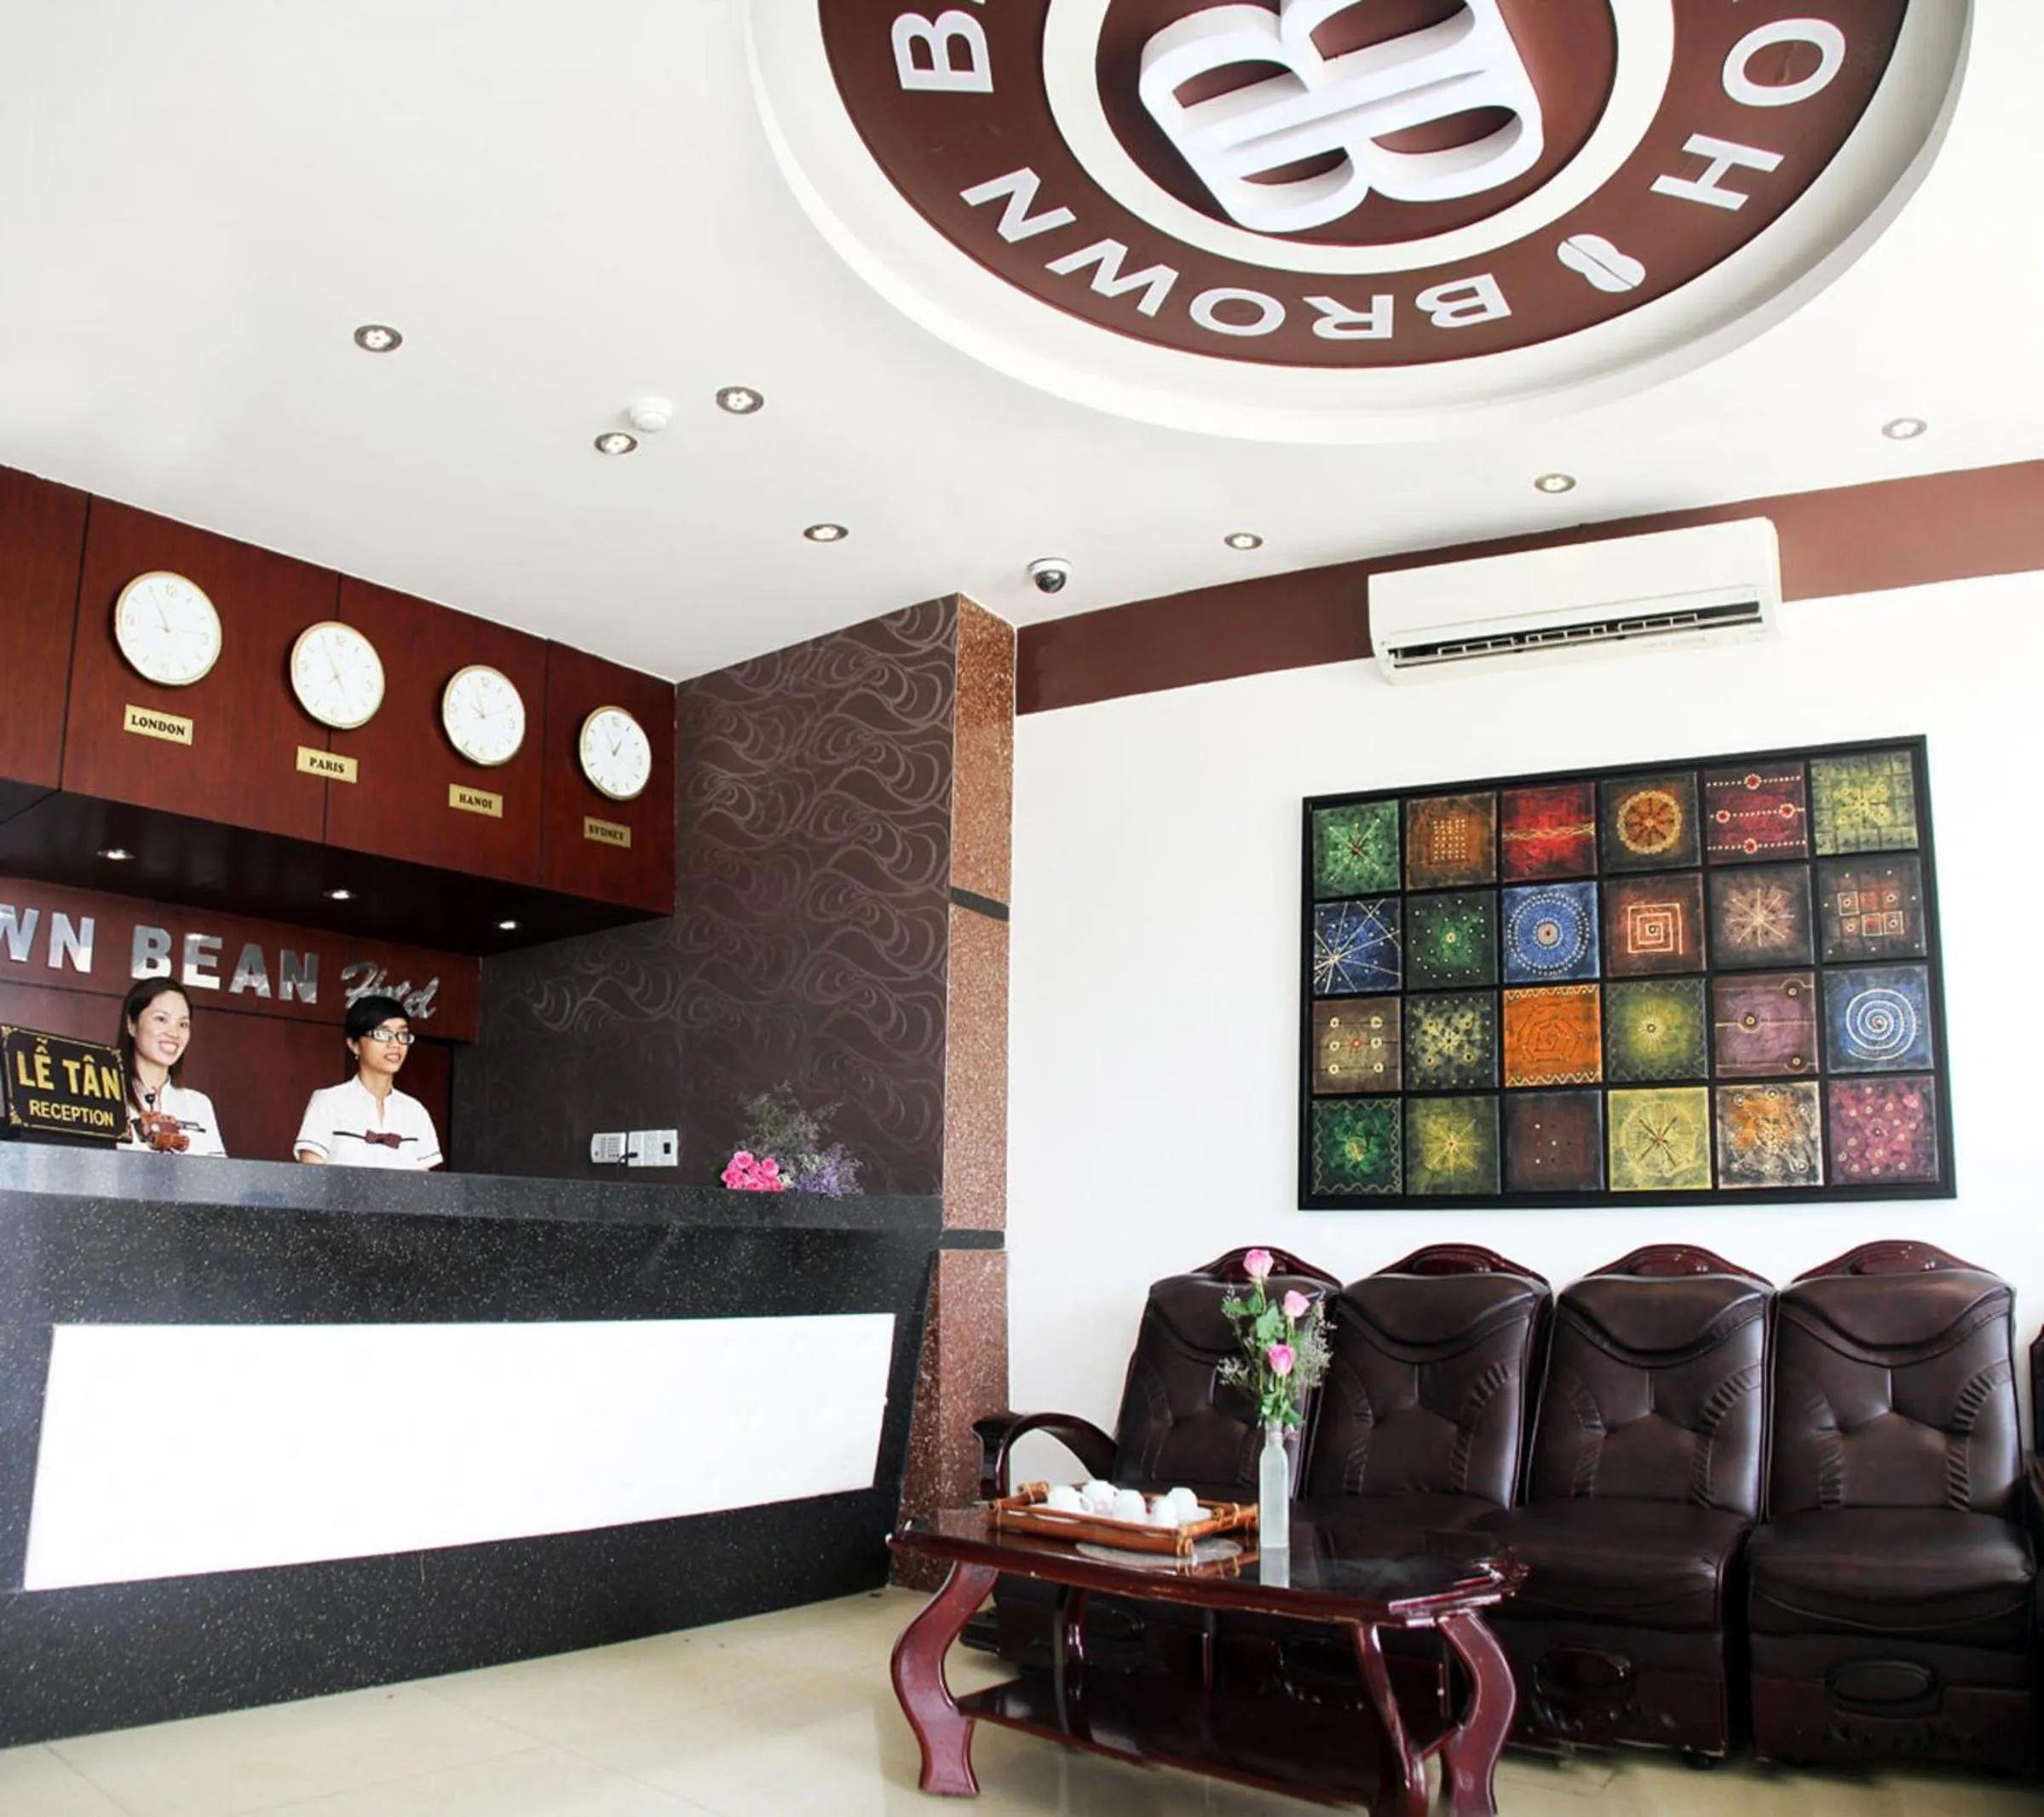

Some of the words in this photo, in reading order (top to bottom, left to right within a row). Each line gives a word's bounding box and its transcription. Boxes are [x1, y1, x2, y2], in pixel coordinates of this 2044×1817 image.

[1650, 0, 1846, 211] HO
[959, 167, 1513, 340] BROWN
[130, 714, 187, 737] LONDON
[308, 756, 346, 775] PARIS
[458, 793, 494, 810] HANOI
[588, 823, 625, 841] SYDNEY
[131, 925, 320, 1004] BEAN
[17, 1037, 55, 1090] LỄ
[62, 1054, 122, 1102] TÂN
[28, 1099, 114, 1128] RECEPTION
